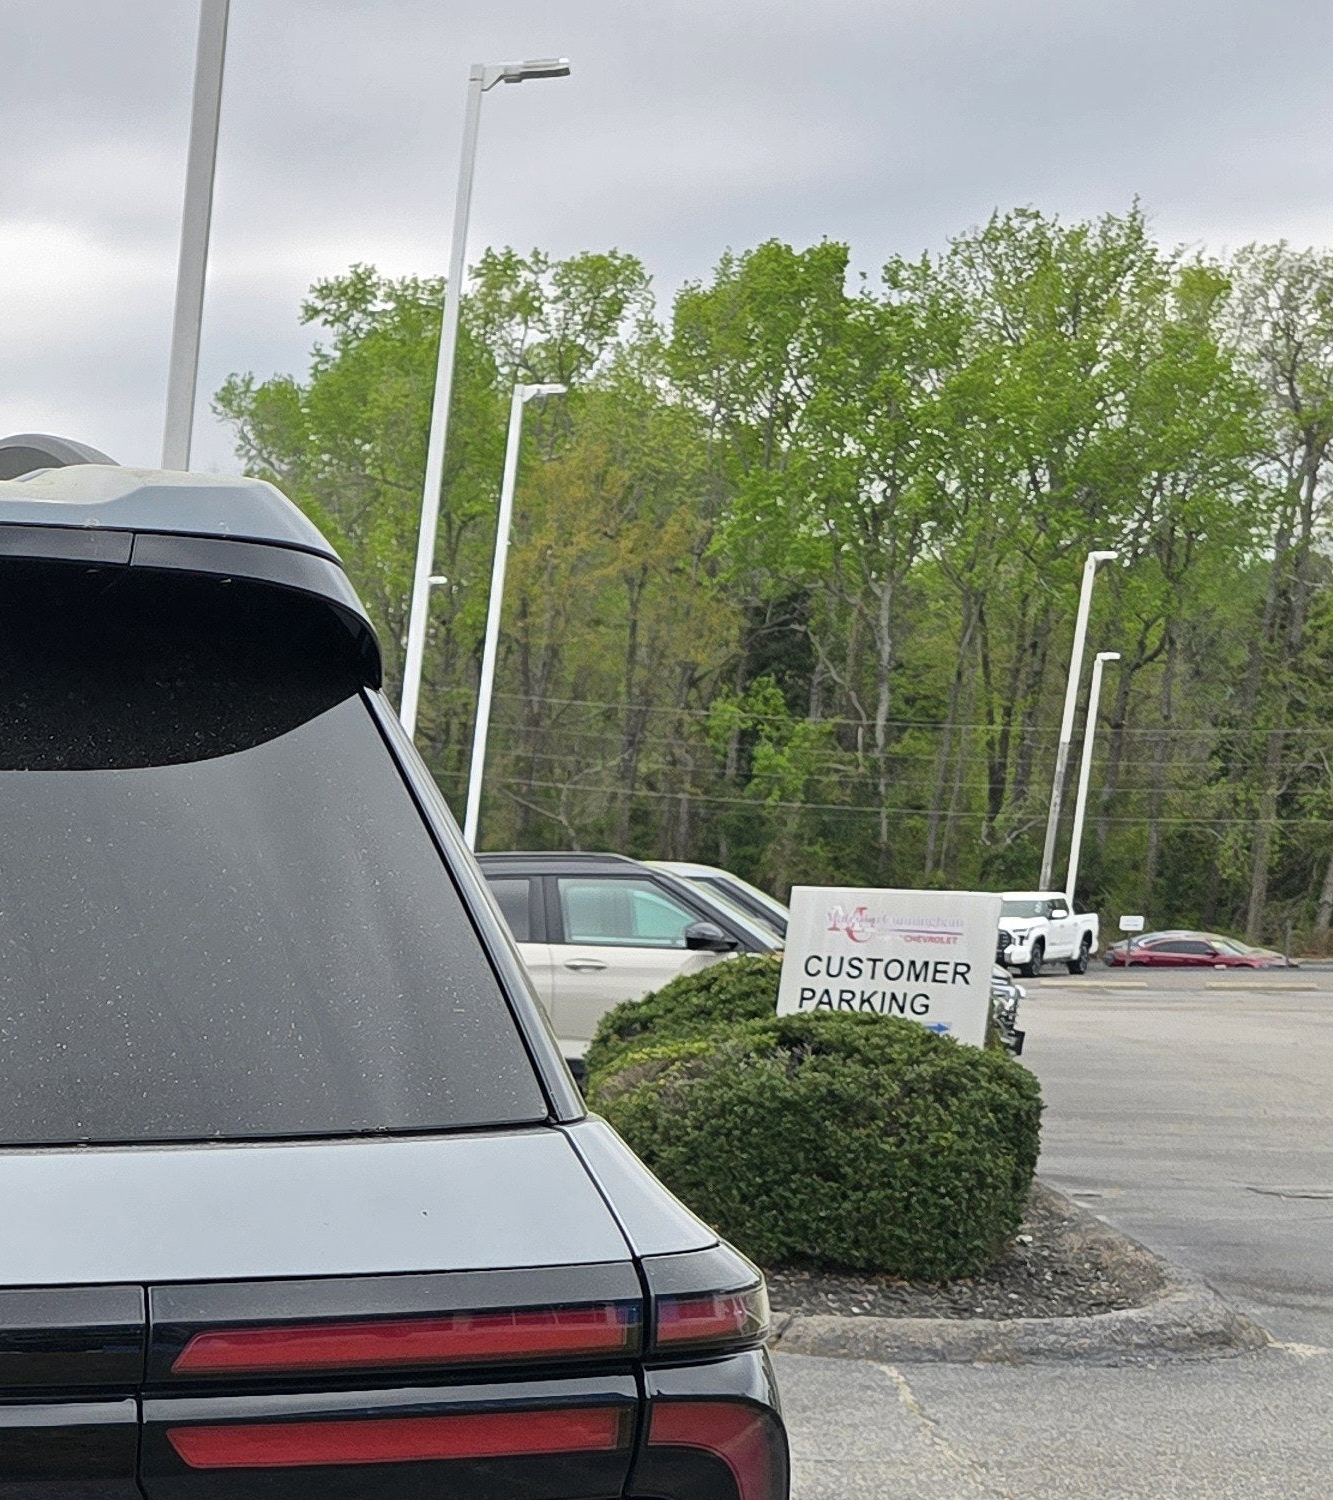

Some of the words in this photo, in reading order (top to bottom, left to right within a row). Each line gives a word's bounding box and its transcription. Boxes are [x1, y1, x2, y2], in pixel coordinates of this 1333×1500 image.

[904, 934, 959, 945] CHEVROLET
[804, 955, 972, 985] CUSTOMER
[798, 988, 930, 1015] PARKING
